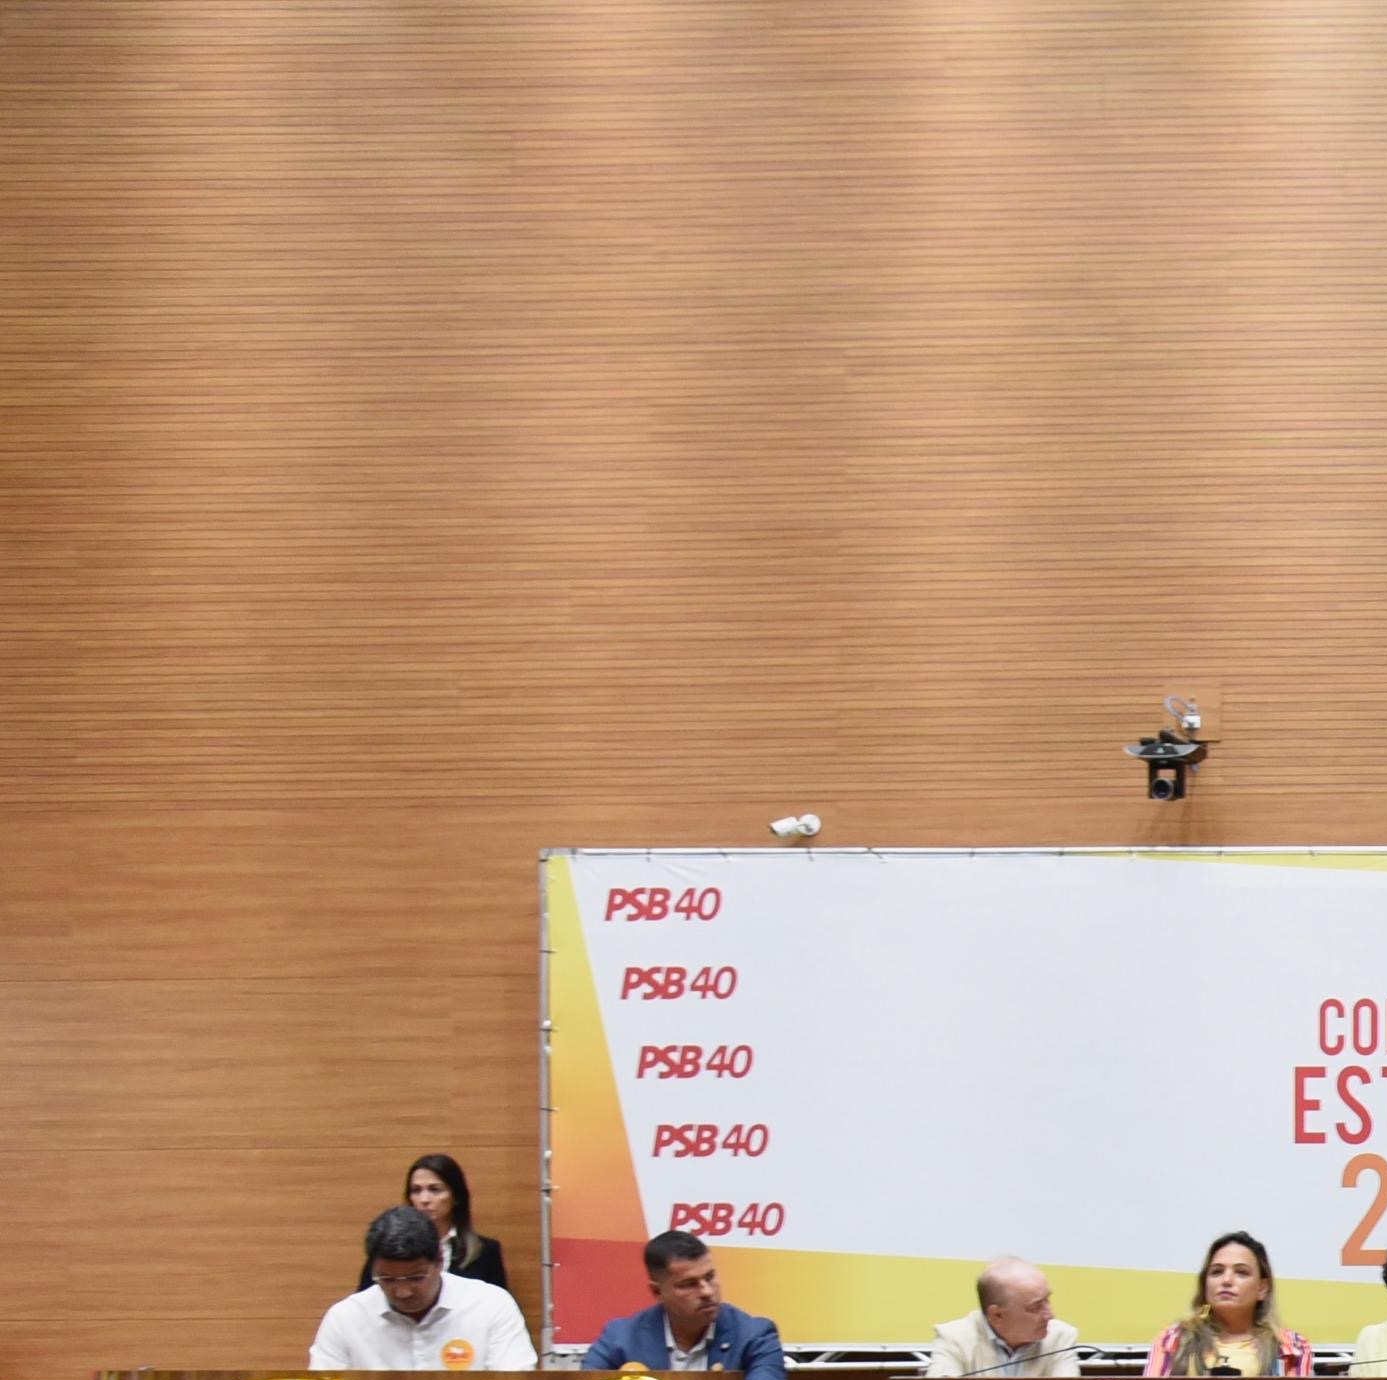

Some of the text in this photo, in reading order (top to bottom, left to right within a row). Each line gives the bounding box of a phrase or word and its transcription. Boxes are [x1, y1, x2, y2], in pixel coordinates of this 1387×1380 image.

[605, 887, 721, 921] PSB 40
[621, 965, 738, 1000] PSB 40
[637, 1044, 753, 1079] PSB 40
[653, 1123, 769, 1158] PSB 40
[669, 1202, 785, 1237] PSB 40
